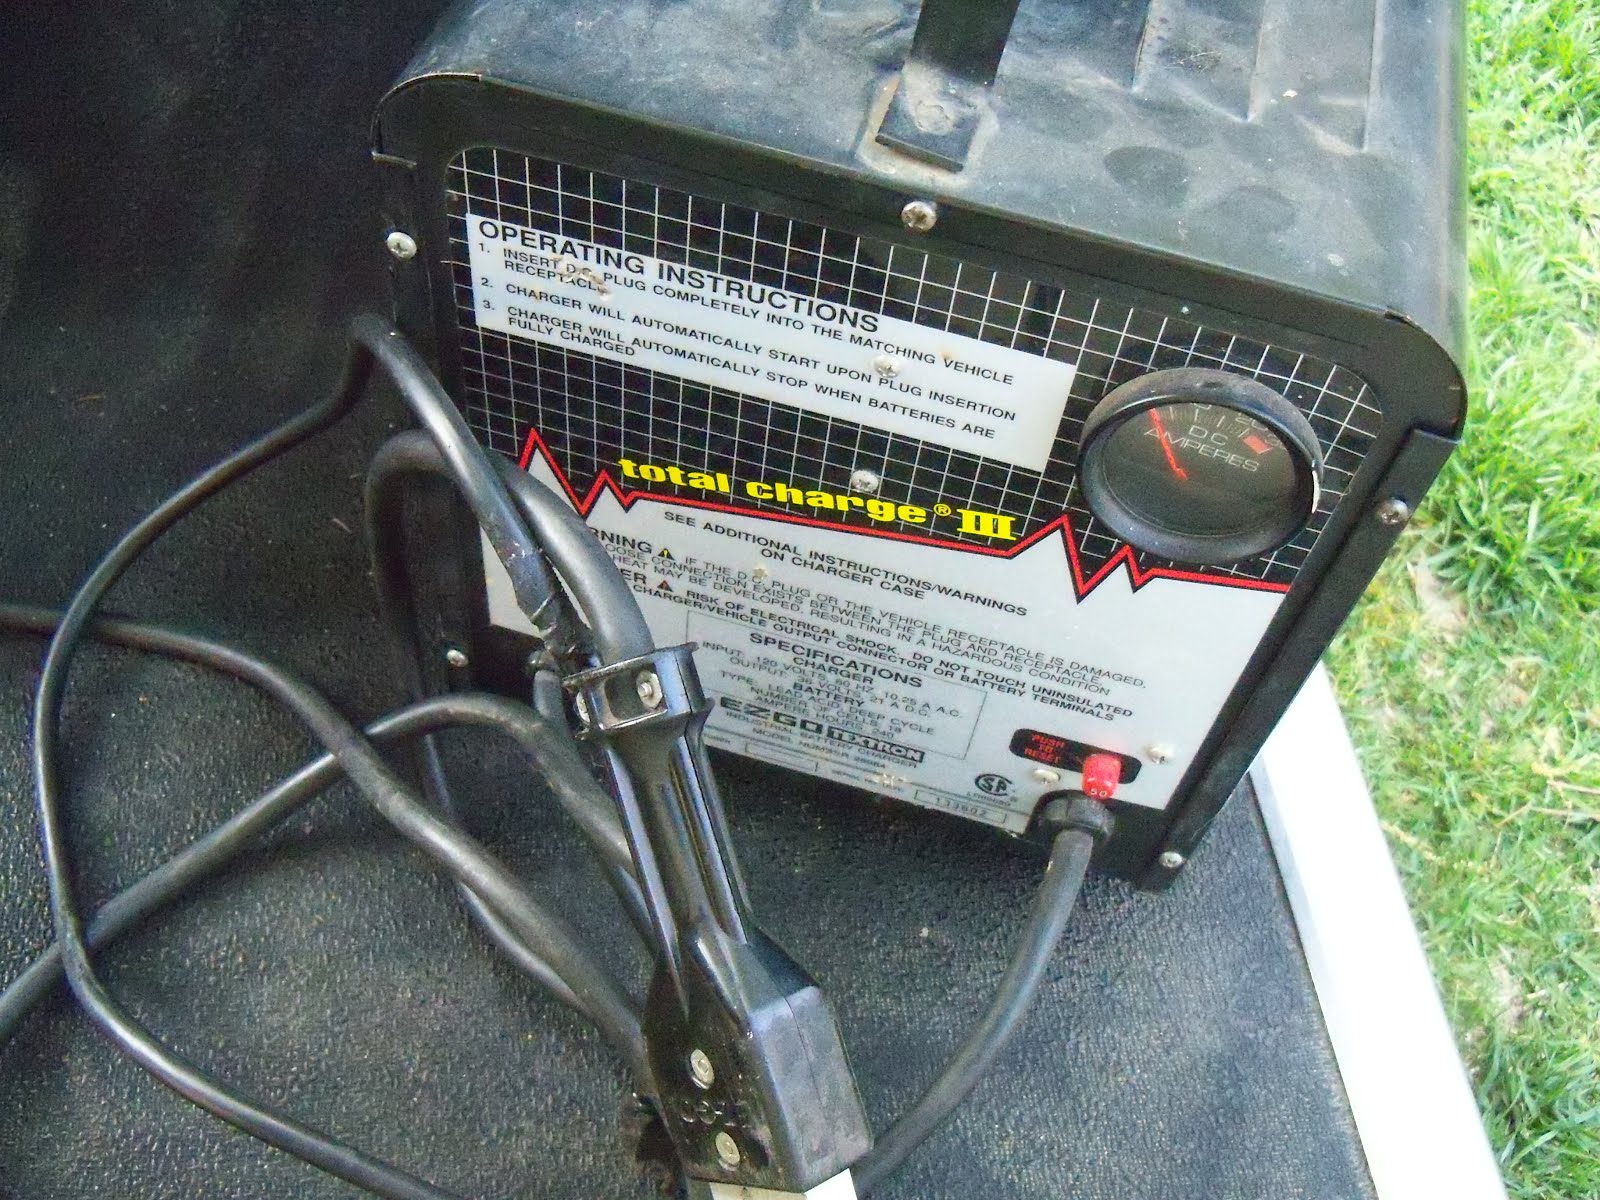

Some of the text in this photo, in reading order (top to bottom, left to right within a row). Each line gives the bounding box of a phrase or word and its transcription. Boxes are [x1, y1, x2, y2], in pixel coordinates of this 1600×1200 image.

[478, 220, 879, 333] OPERATING INSTRUCTIONS
[479, 243, 490, 253] 1.
[504, 248, 560, 270] INSERT
[604, 273, 646, 291] PLUG
[654, 285, 760, 318] COMPLETELY
[767, 313, 804, 330] INTO
[812, 324, 842, 340] THE
[850, 334, 936, 364] MATCHING
[944, 359, 1013, 385] VEHICLE
[505, 260, 606, 293] RECEPTACL
[481, 277, 1016, 421] 2. CHARGER WILL AUTOMATICALLY START UPON PLUG INSERTION
[483, 300, 996, 439] 3. CHARGER WILL AUTOMATICALLY STOP WHEN BATTERIES ARE
[509, 318, 635, 356] FULLY CHARGED
[1144, 428, 1259, 472] AMPERES
[1188, 424, 1229, 446] DC
[617, 458, 730, 493] total
[746, 480, 927, 524] charge
[957, 507, 1017, 541] III
[664, 511, 1027, 616] SEE ADDITIONAL INSTRUCTIONS/WARNINGS
[761, 549, 925, 599] ON CHARGER CASE
[652, 557, 746, 588] CONNECTION
[753, 585, 804, 604] EXISTS
[810, 600, 881, 625] BETWEEN
[889, 621, 915, 634] THE
[922, 630, 961, 646] PLUG
[967, 643, 997, 656] AND
[654, 566, 682, 579] MAY
[689, 575, 707, 586] BE
[810, 609, 891, 637] RESULTING
[898, 633, 911, 642] IN
[916, 638, 926, 646] A
[932, 643, 1022, 672] HAZARDOUS
[1029, 667, 1110, 695] CONDITION
[686, 556, 698, 565] IF
[704, 562, 731, 575] THE
[772, 580, 810, 597] PLUG
[817, 593, 838, 605] OR
[845, 600, 872, 614] THE
[880, 610, 941, 632] VEHICLE
[948, 628, 1044, 660] RECEPTACLE
[1051, 656, 1064, 665] IS
[1070, 662, 1146, 688] DAMAGED.
[633, 585, 1114, 721] CHARGER/VEHICLE OUTPUT CONNECTOR OR BATTERY TERMINALS
[687, 590, 718, 605] RISK
[725, 601, 744, 611] OF
[751, 607, 840, 638] ELECTRICAL
[913, 652, 933, 663] DO
[940, 660, 970, 672] NOT
[976, 669, 1026, 688] TOUCH
[1032, 685, 1132, 717] UNINSULATED
[750, 632, 922, 687] SPECIFICATIONS
[793, 657, 873, 684] CHARGER
[793, 682, 864, 706] BATTERY
[750, 687, 807, 708] NUMBER
[768, 684, 802, 698] LEAD
[850, 707, 885, 720] DEEP
[890, 718, 935, 735] CYCLE
